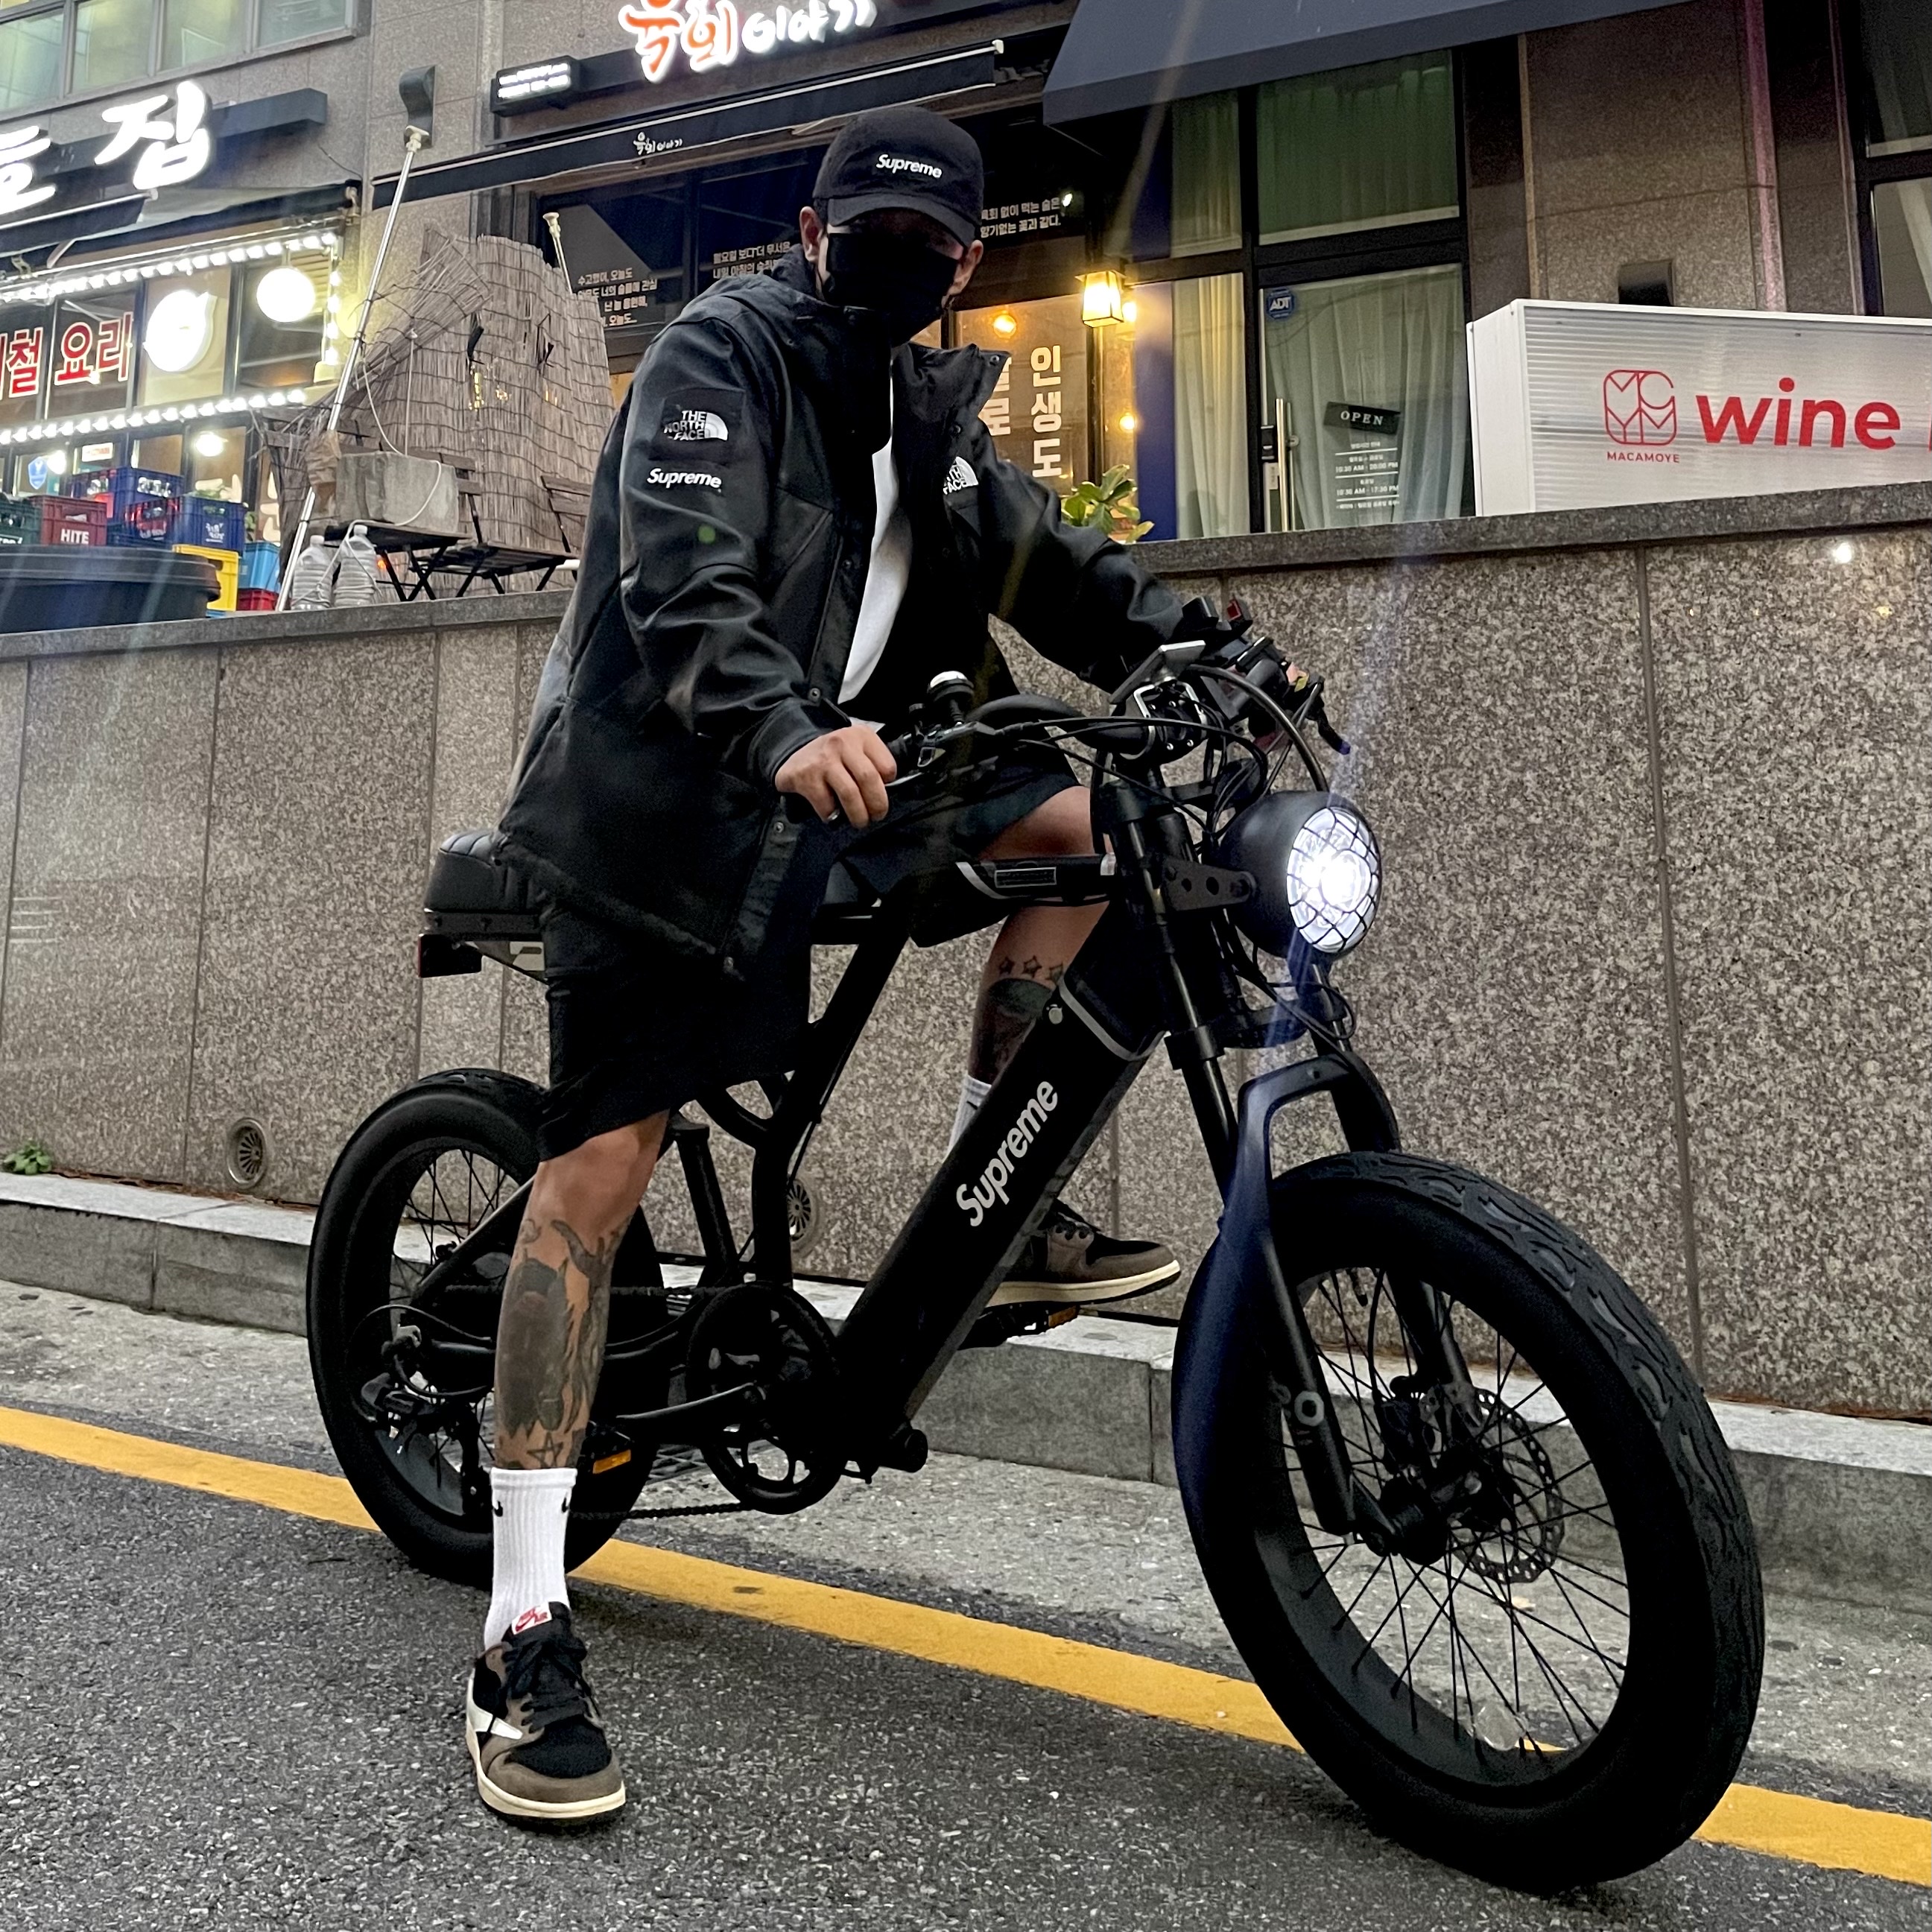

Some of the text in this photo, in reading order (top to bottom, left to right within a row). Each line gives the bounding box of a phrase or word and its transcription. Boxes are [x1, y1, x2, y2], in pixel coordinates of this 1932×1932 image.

[875, 153, 943, 178] Supreme
[1000, 204, 1019, 219] 없이
[1021, 202, 1040, 215] 먹는
[1270, 297, 1292, 311] ADT
[54, 311, 133, 386] 요리
[681, 411, 706, 422] THE
[1030, 345, 1062, 478] 인생도
[1340, 411, 1384, 425] OPEN
[1695, 376, 1901, 450] wine
[664, 420, 705, 433] NORTH
[674, 429, 705, 441] FACE
[1606, 451, 1680, 463] MACAMOYE
[647, 467, 722, 489] Supreme
[60, 528, 89, 545] HITE
[956, 1080, 1058, 1227] Supreme
